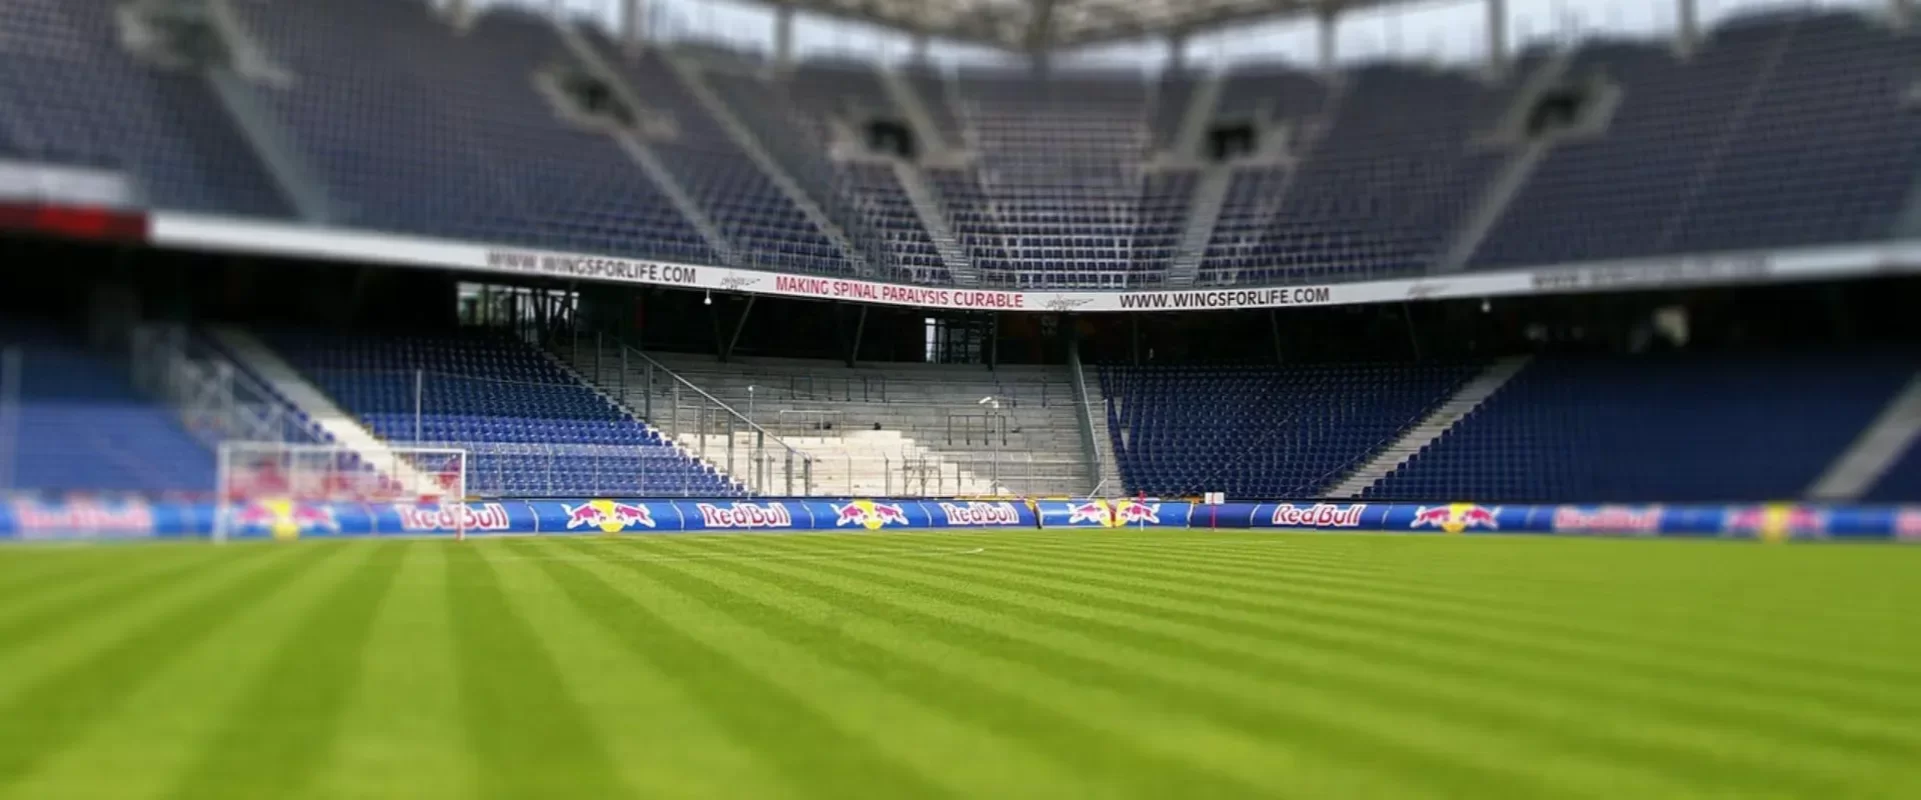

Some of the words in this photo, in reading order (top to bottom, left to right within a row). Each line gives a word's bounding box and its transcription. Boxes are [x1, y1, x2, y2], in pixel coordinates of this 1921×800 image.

[776, 276, 829, 295] MAKING
[833, 281, 878, 300] SPINAL
[883, 286, 949, 306] PARALYSIS
[953, 292, 1024, 308] CURABLE
[1119, 287, 1330, 309] WWW.WINGSFORLIFE.COM
